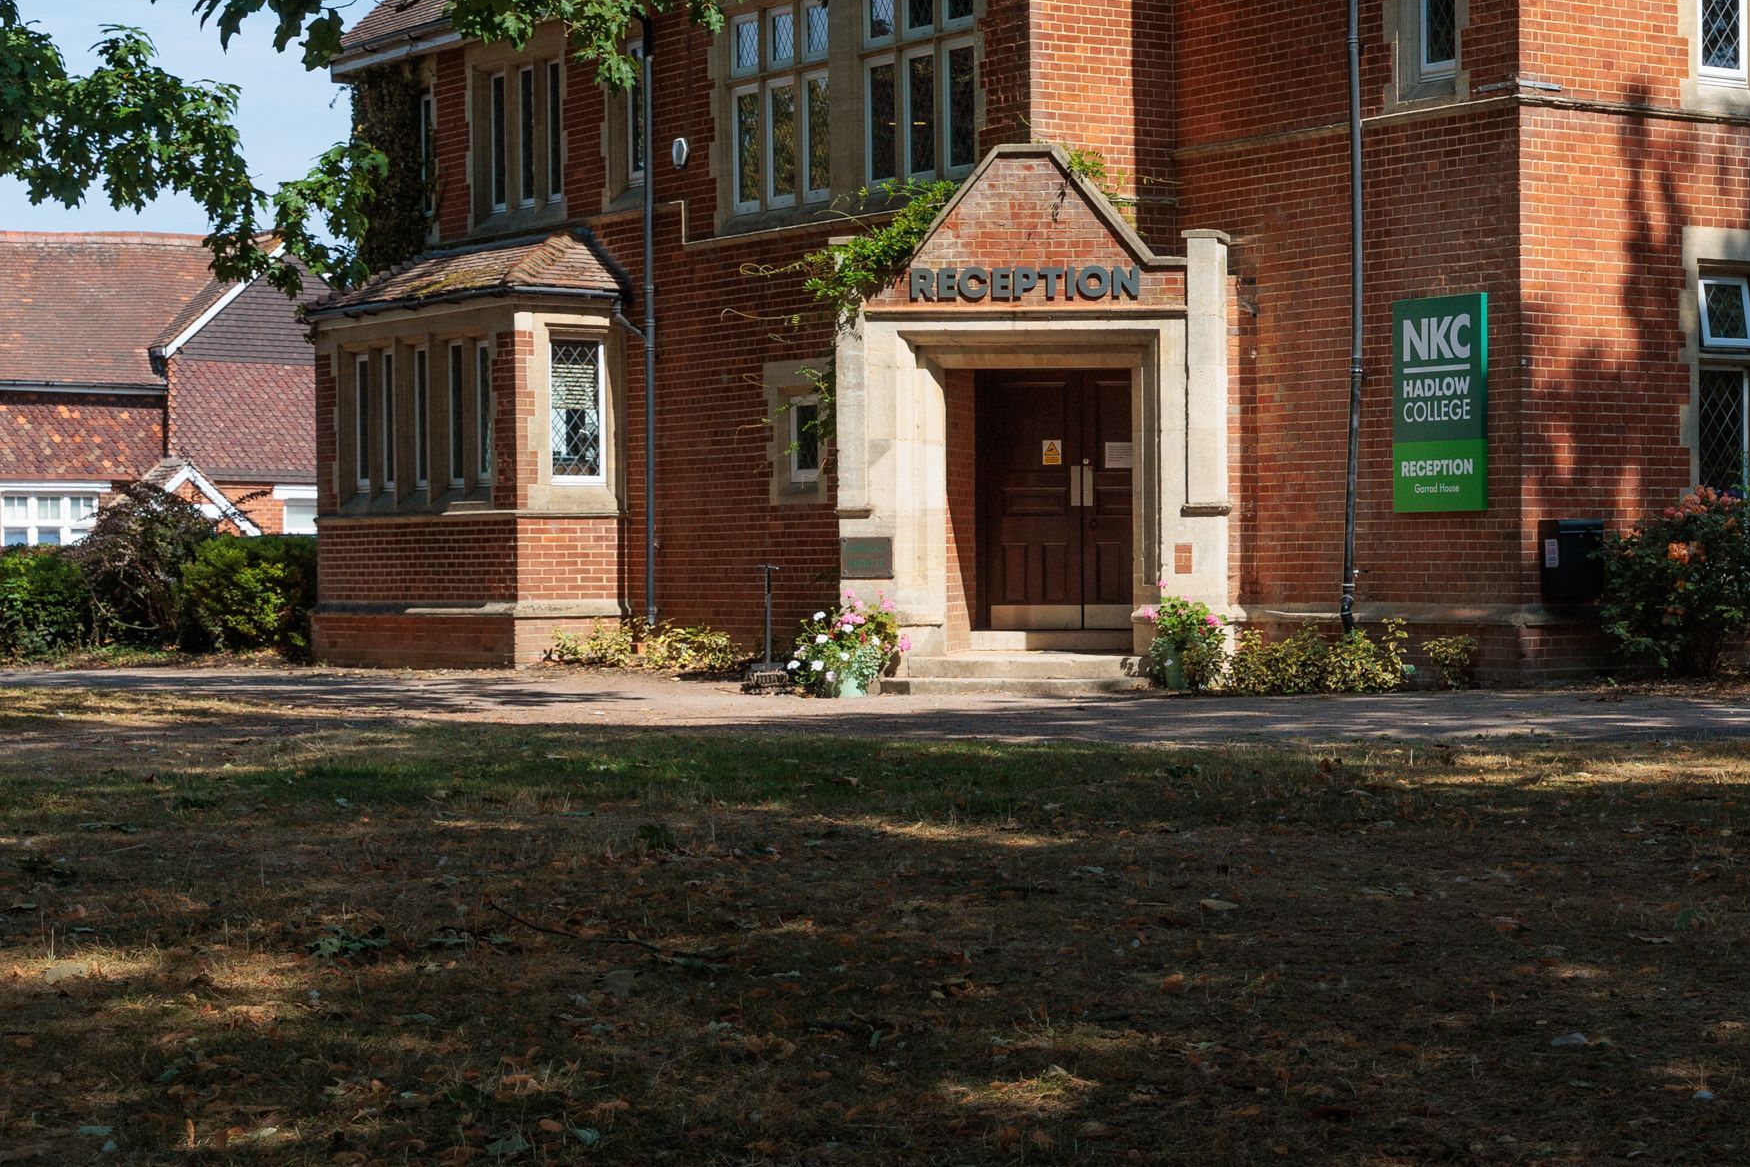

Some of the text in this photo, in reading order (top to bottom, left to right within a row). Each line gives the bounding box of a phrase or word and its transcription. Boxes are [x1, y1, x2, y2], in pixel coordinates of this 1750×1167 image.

[910, 265, 1140, 301] RECEPTION
[1403, 313, 1471, 362] NKC
[1403, 376, 1471, 399] HADLOW
[1403, 399, 1471, 423] COLLEGE
[1401, 458, 1474, 477] RECEPTION
[1414, 482, 1460, 494] Garrad House
